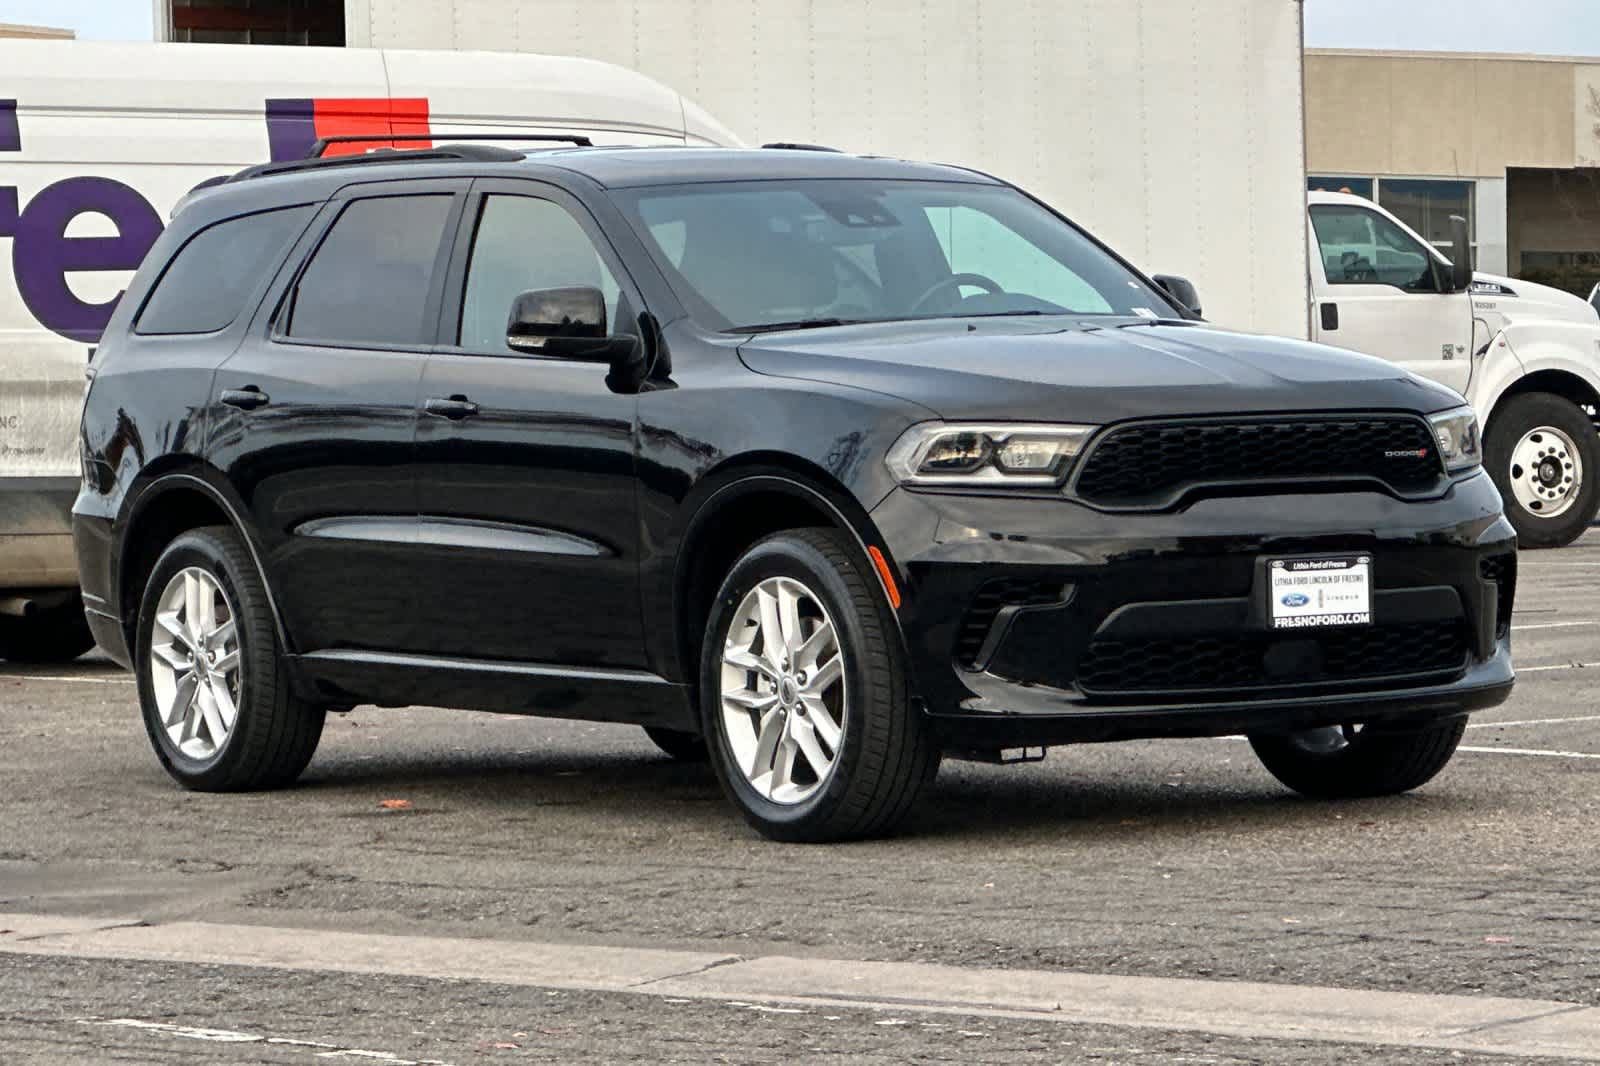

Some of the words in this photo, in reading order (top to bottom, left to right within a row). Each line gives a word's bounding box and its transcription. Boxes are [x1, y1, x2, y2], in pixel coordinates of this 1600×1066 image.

[1293, 562, 1309, 570] Lithia
[1275, 576, 1292, 585] LITHIA
[1293, 576, 1308, 584] FORD
[1309, 575, 1333, 584] LINCOLN
[1334, 575, 1341, 583] OF
[1342, 574, 1364, 583] FRESNO
[1274, 613, 1370, 628] FRESNOFORD.COM
